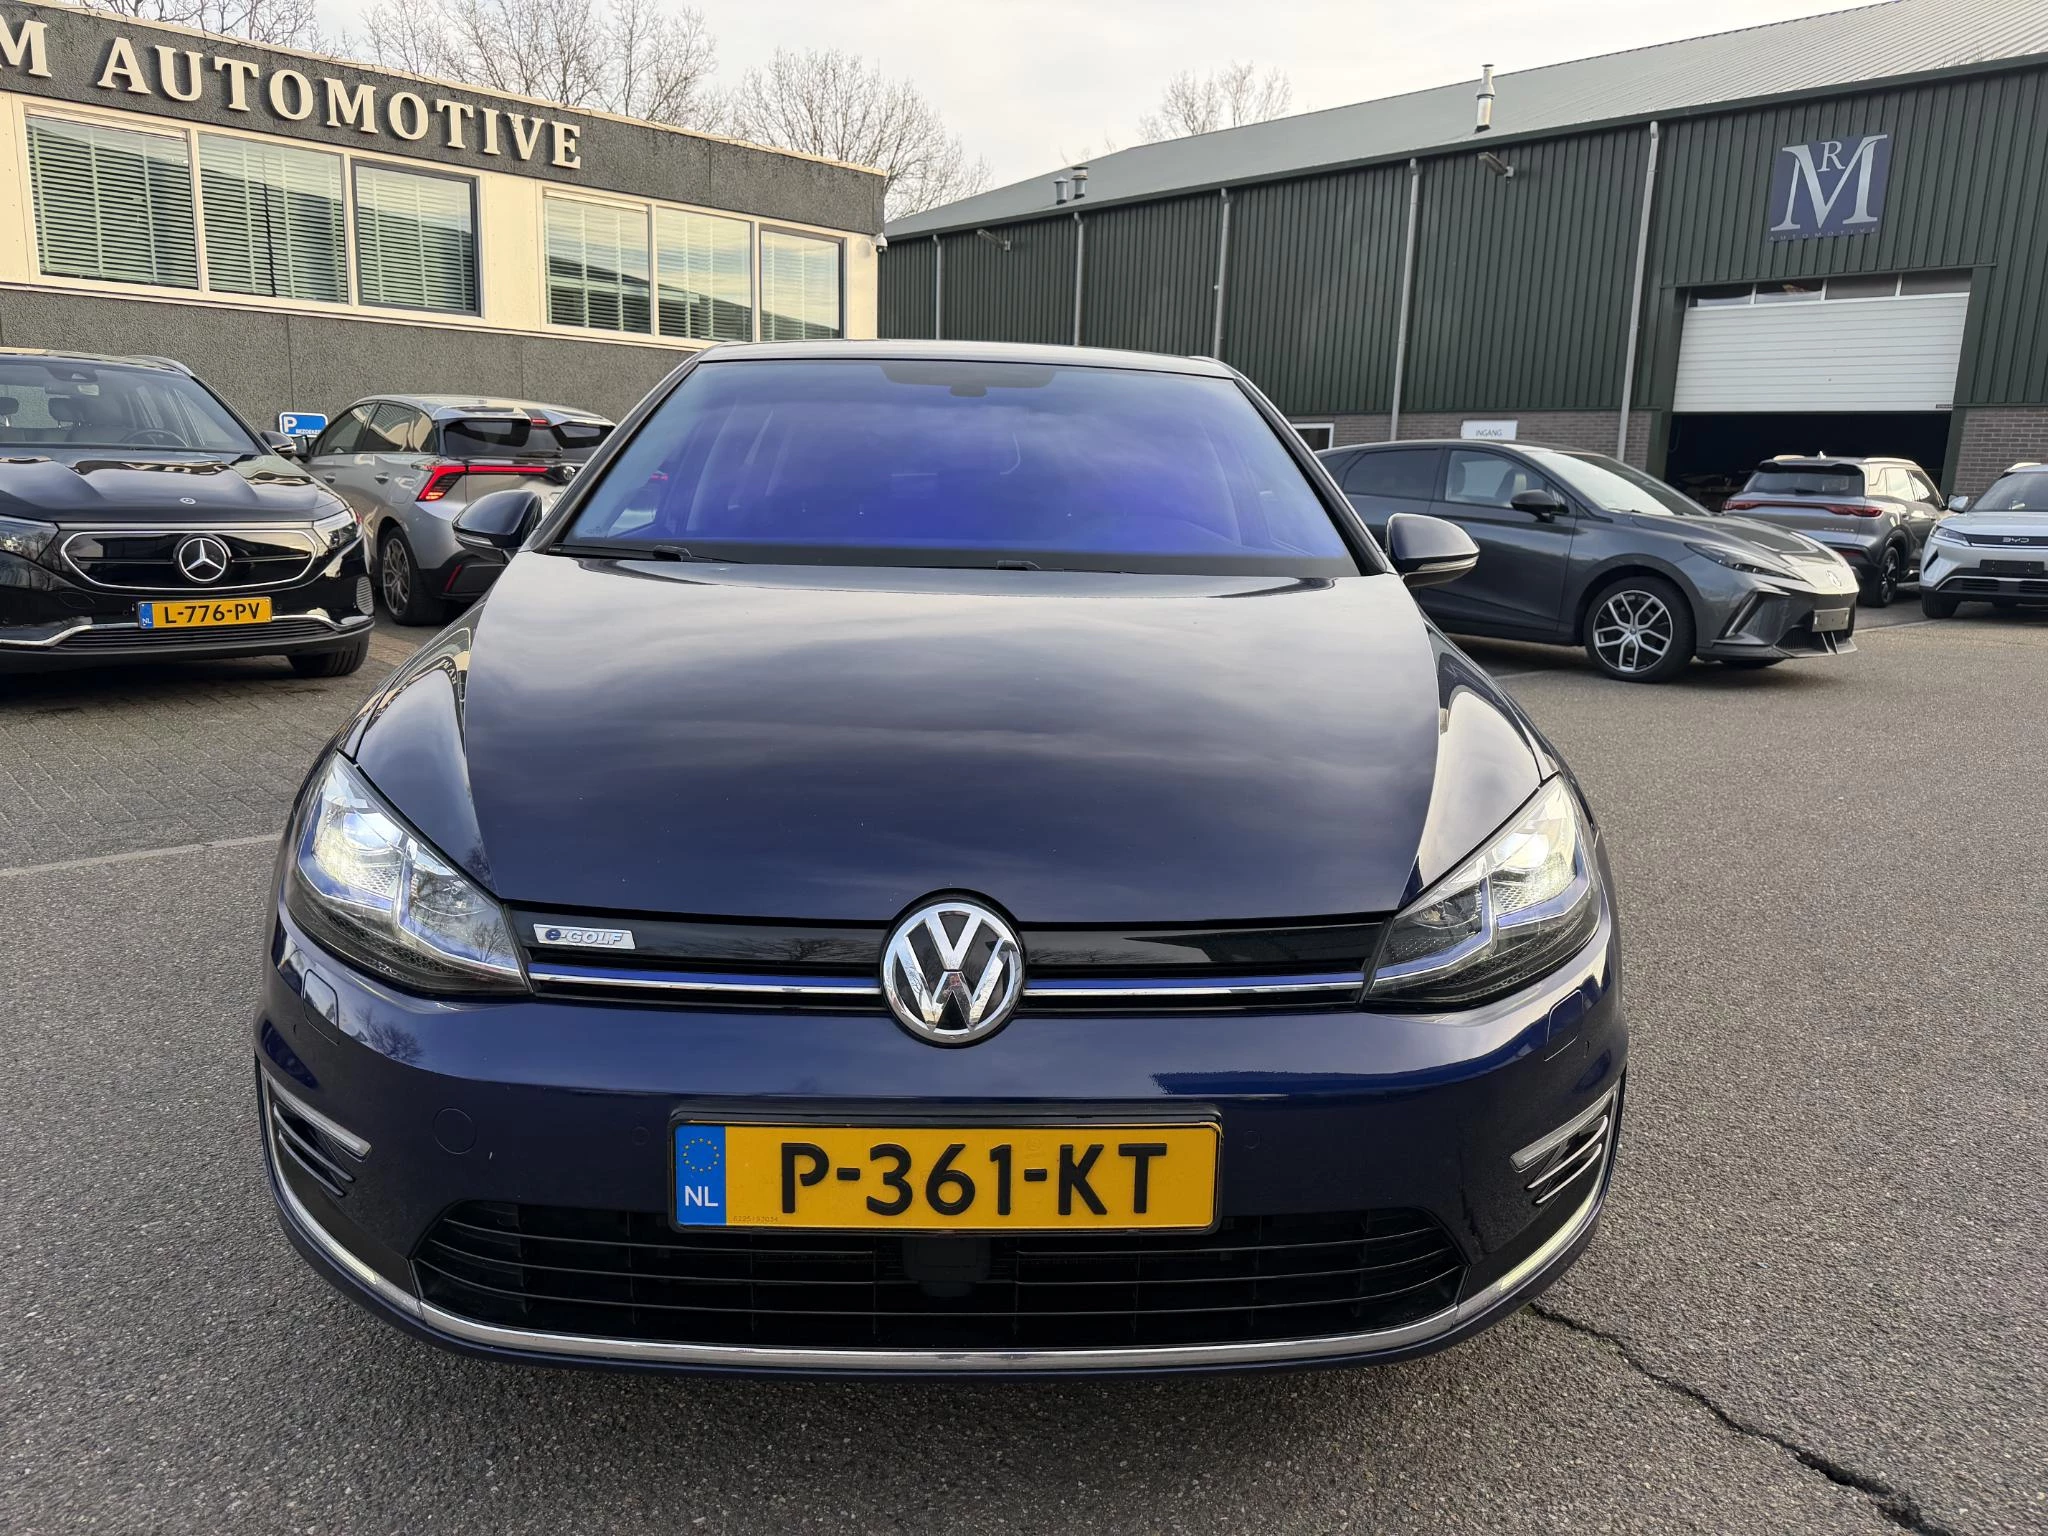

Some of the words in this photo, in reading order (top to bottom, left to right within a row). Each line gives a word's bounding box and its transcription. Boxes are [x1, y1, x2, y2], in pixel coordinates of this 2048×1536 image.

[97, 36, 582, 170] AUTOMOTIVE
[283, 416, 297, 433] P
[1475, 429, 1503, 437] INGANG
[142, 617, 153, 625] NL
[164, 602, 260, 624] L-776-PV
[781, 1142, 1168, 1216] P-361-KT
[684, 1185, 719, 1207] NL
